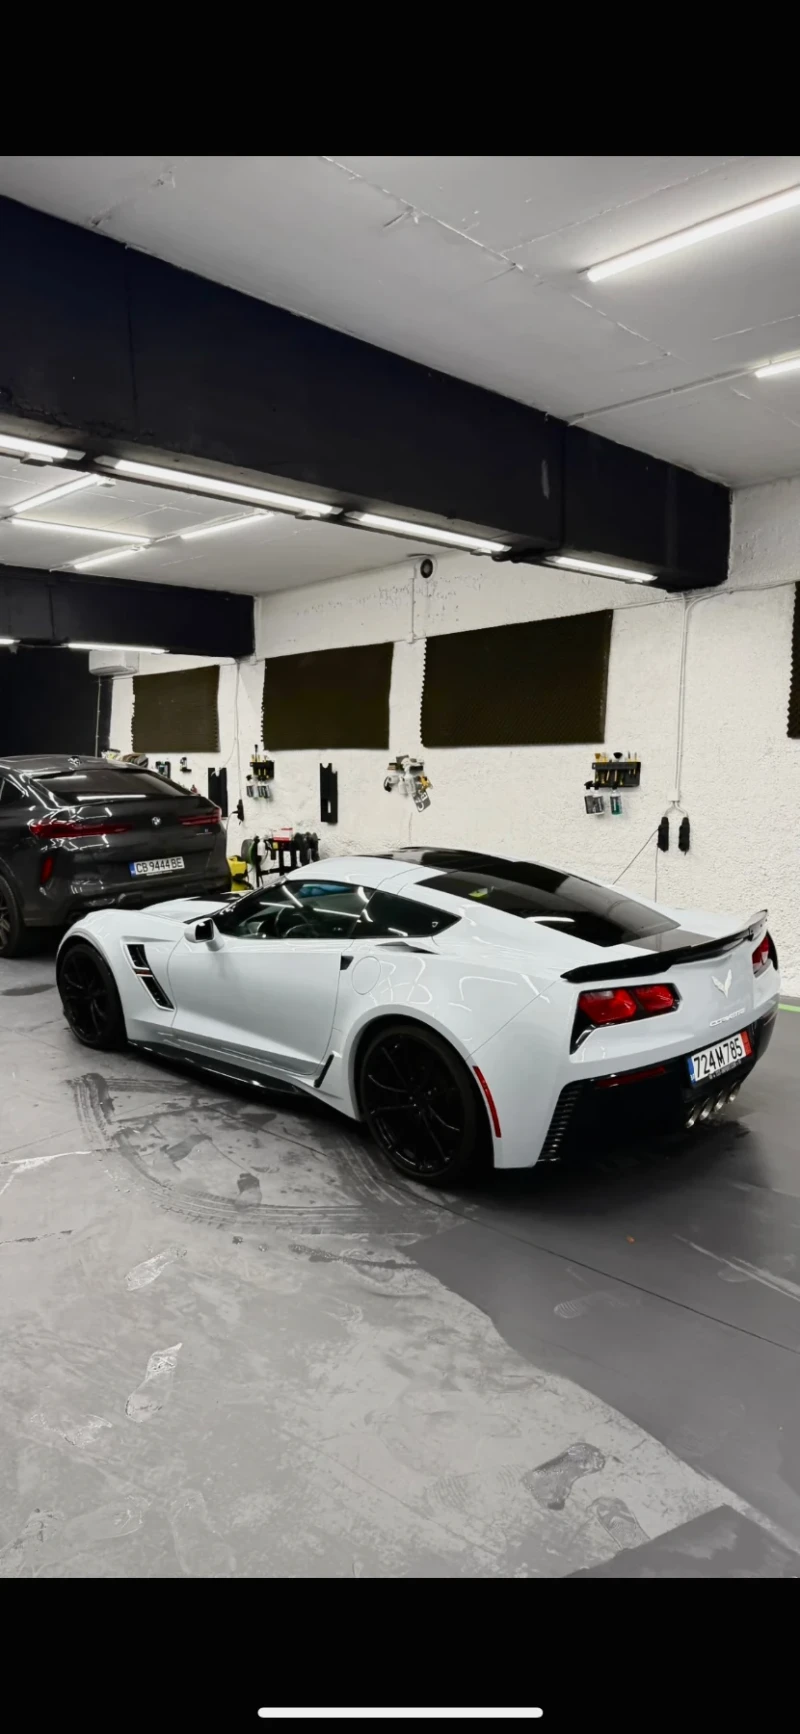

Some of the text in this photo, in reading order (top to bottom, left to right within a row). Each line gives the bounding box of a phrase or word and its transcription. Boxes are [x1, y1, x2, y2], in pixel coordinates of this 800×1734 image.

[136, 858, 183, 873] CB 9444 BE
